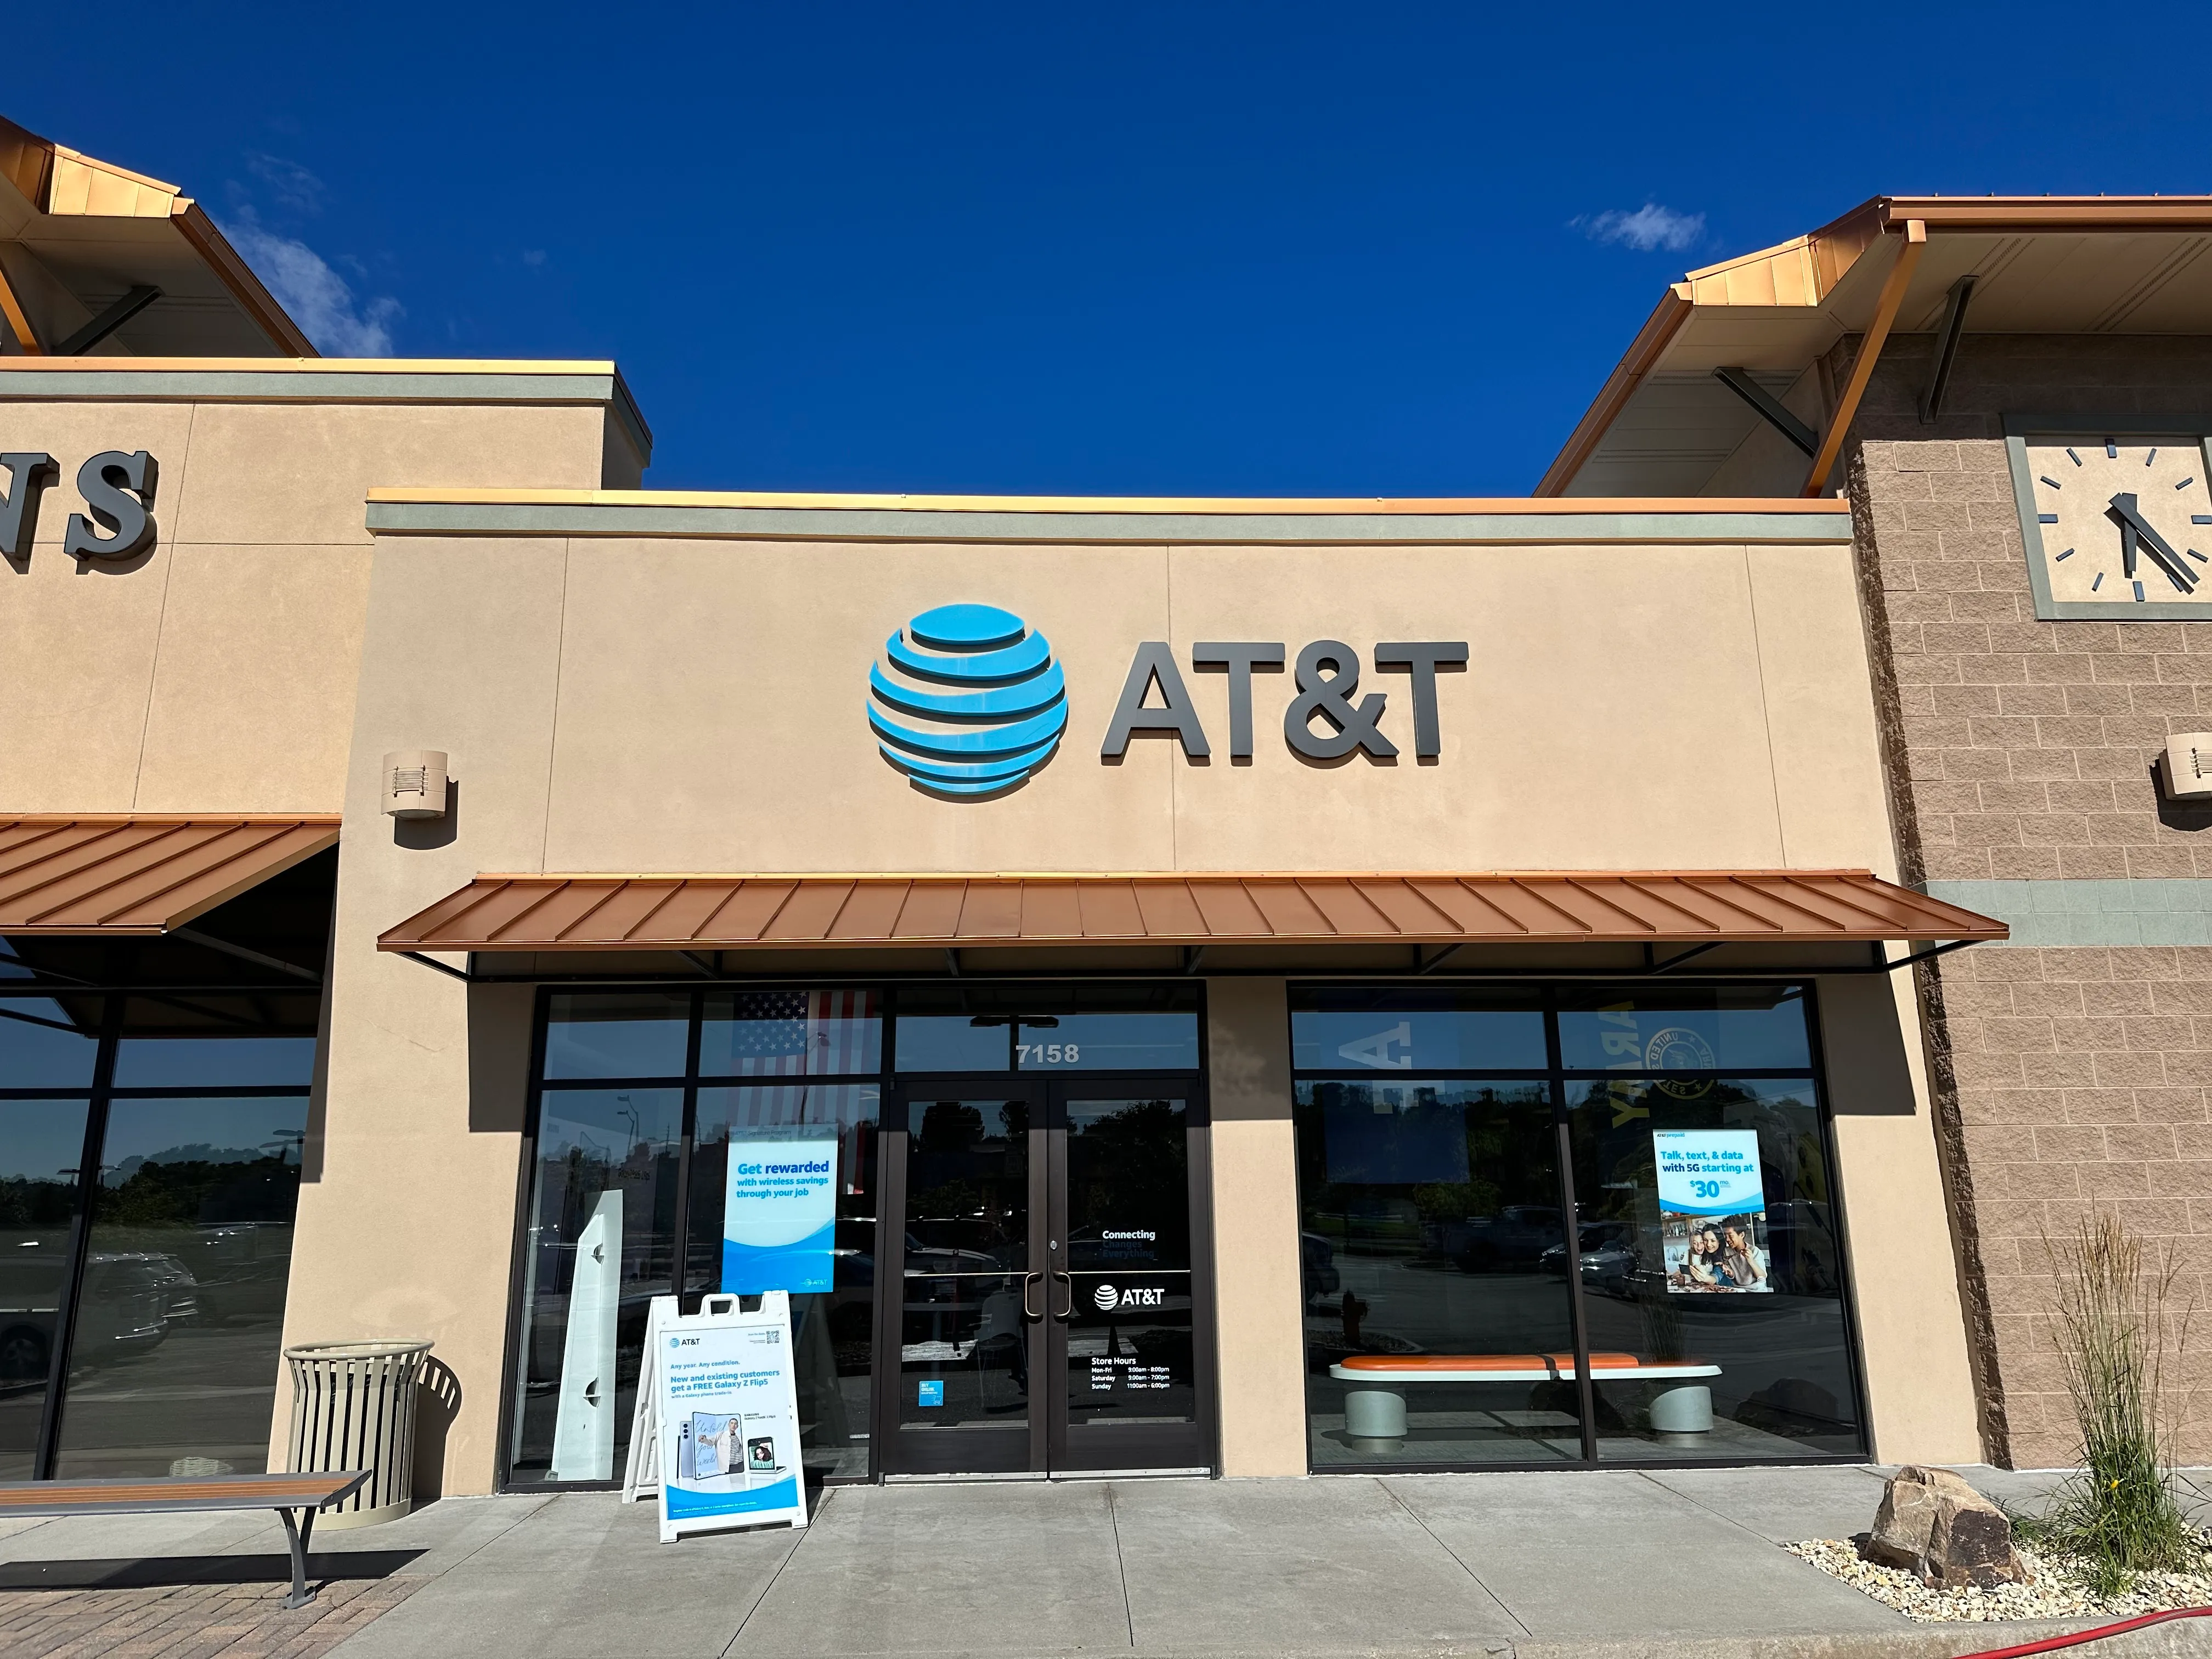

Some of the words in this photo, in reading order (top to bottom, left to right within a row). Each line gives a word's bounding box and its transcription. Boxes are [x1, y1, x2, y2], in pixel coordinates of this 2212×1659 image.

[1101, 640, 1469, 764] AT&T
[1015, 1044, 1079, 1063] 7158
[1661, 1151, 1684, 1161] Talk,
[1686, 1152, 1710, 1161] text,
[1722, 1151, 1743, 1159] data
[738, 1163, 762, 1175] Get
[765, 1160, 829, 1174] rewarded
[1662, 1164, 1685, 1172] with
[1687, 1164, 1700, 1172] 5G
[1701, 1163, 1741, 1174] starting
[737, 1178, 757, 1186] with
[759, 1177, 794, 1186] wireless
[796, 1176, 828, 1186] savings
[736, 1189, 771, 1199] through
[773, 1189, 793, 1198] your
[794, 1188, 809, 1198] job
[1102, 1229, 1155, 1240] Connecting
[1103, 1240, 1142, 1250] Changes
[1103, 1249, 1154, 1259] Everything
[1121, 1289, 1165, 1305] AT&T
[670, 1375, 688, 1383] New
[707, 1372, 738, 1381] existing
[740, 1370, 780, 1378] customers
[671, 1384, 685, 1393] get
[693, 1381, 713, 1390] FREE
[715, 1380, 741, 1390] Galaxy
[750, 1378, 768, 1387] Flip5
[695, 1420, 727, 1433] Unfold
